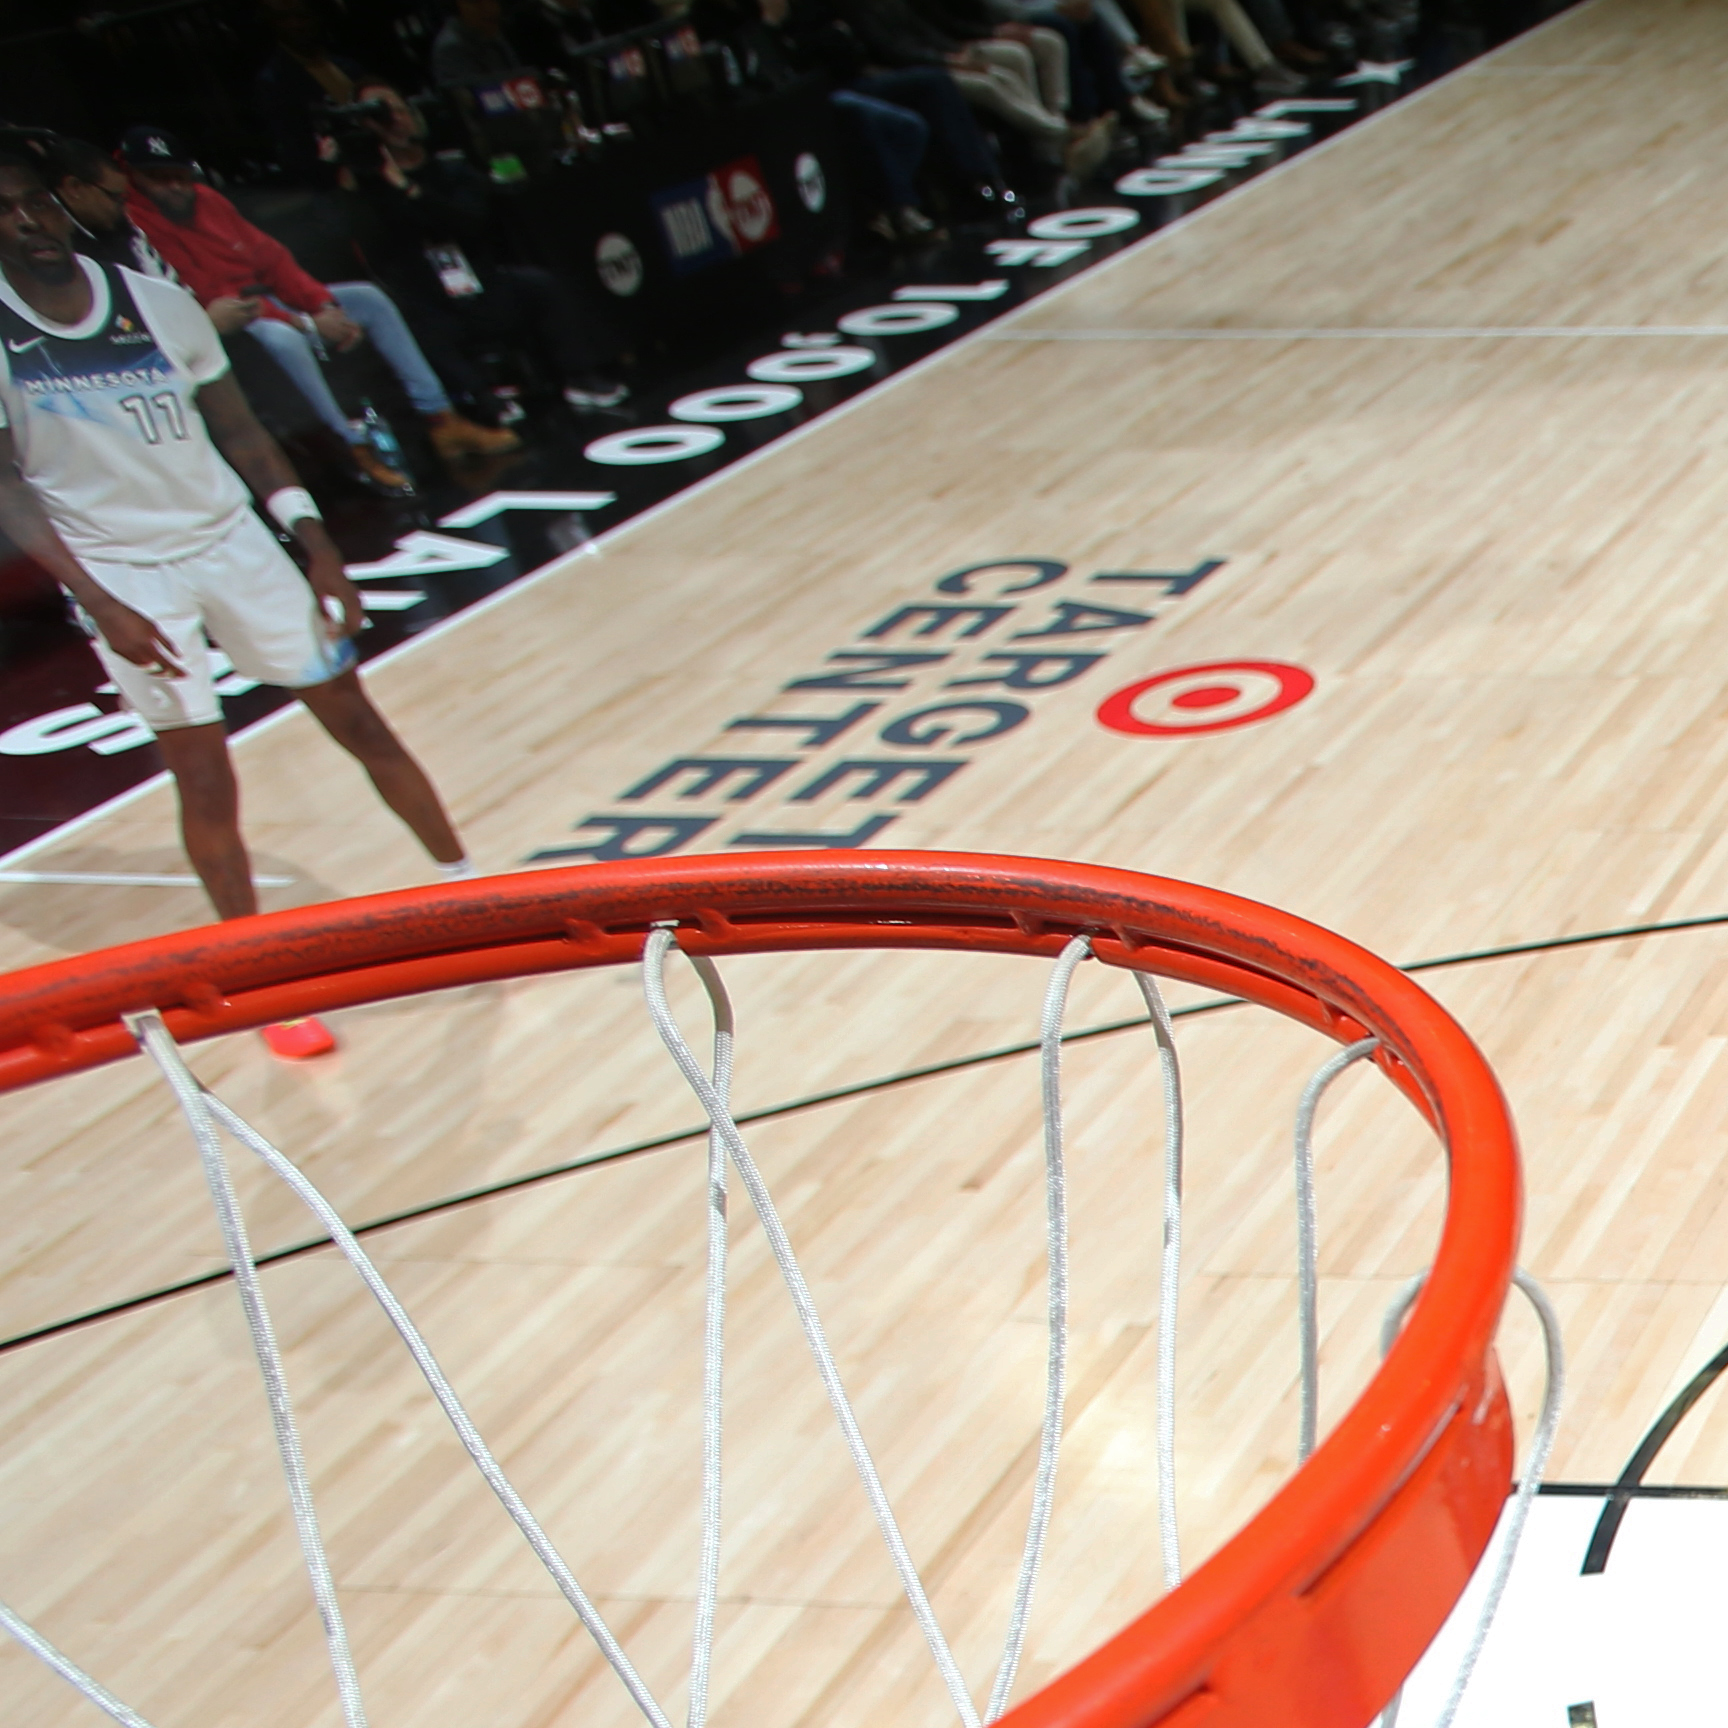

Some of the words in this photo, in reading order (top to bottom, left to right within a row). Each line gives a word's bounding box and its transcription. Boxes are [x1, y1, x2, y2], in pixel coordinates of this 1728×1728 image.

[1114, 98, 1358, 196] LAND
[986, 206, 1141, 267] OF
[23, 365, 169, 395] MINNESOTA
[120, 391, 190, 445] 11
[584, 279, 1009, 466] 10,000
[0, 491, 618, 755] LAS
[526, 556, 1070, 862] CENTER
[730, 559, 1229, 850] TARGET
